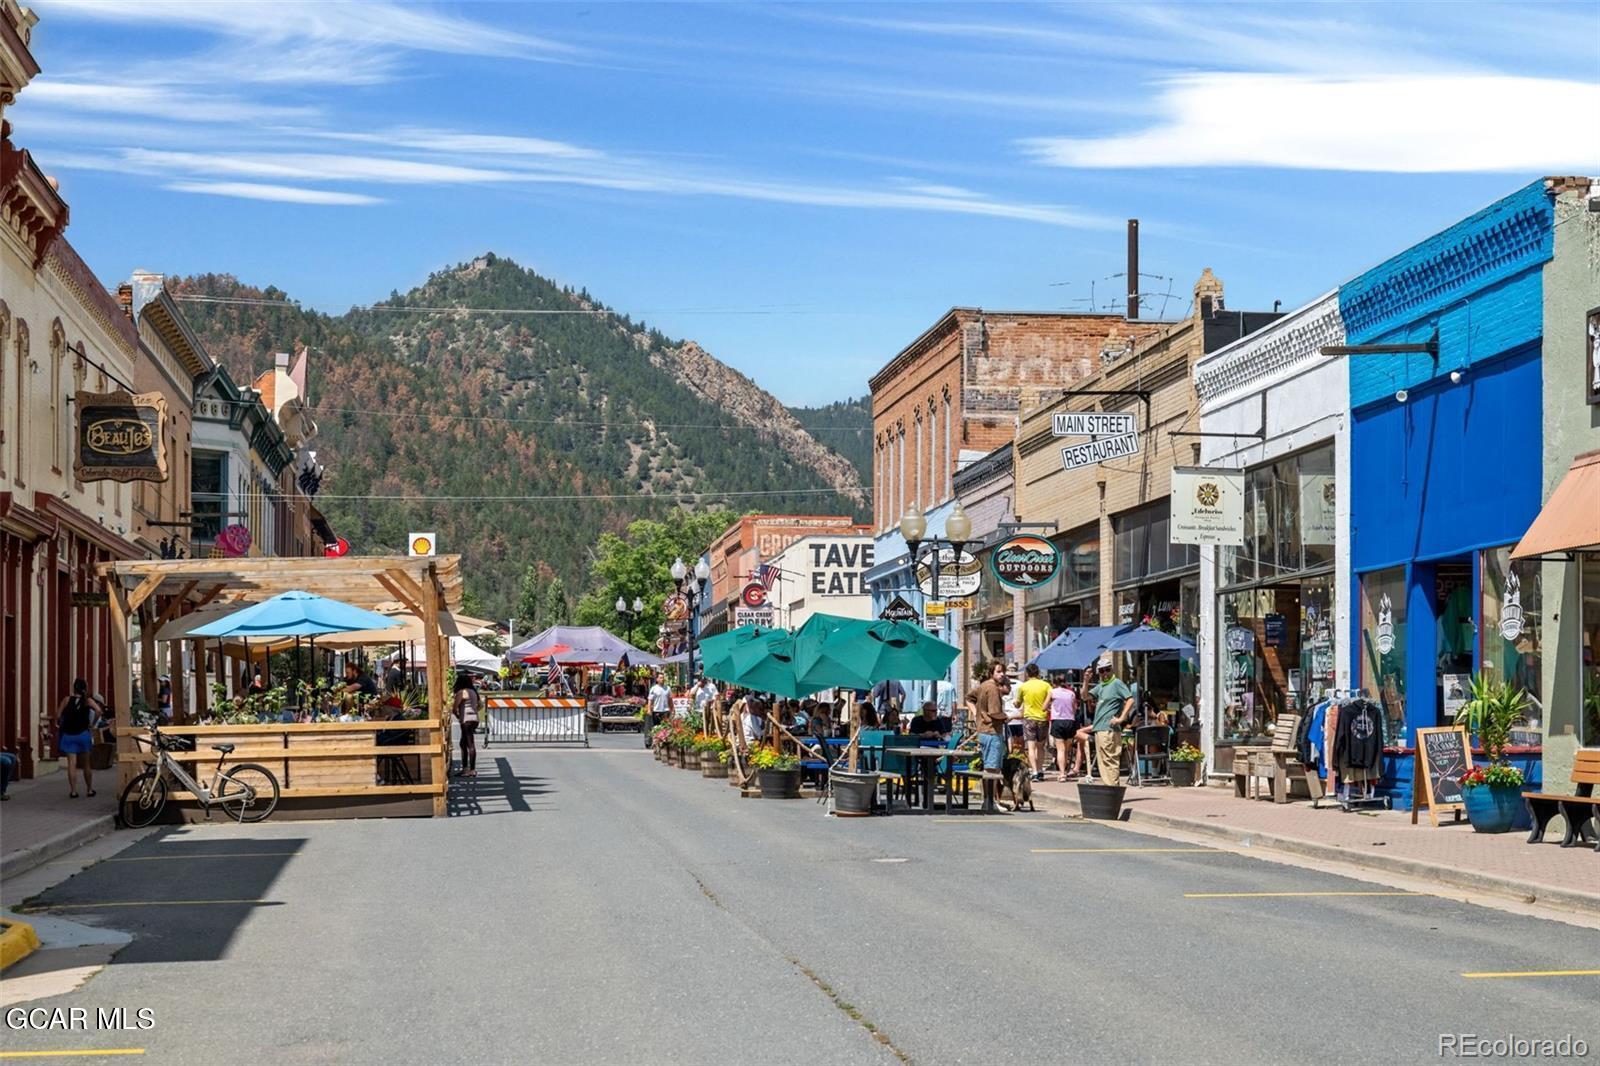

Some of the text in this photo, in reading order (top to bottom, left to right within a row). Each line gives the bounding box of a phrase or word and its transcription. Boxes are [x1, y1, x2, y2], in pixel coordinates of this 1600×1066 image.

[1056, 415, 1130, 433] MAIN STREET
[1064, 434, 1136, 467] RESTAURANT
[809, 543, 874, 568] TAVE
[999, 564, 1054, 572] OUTDOORS
